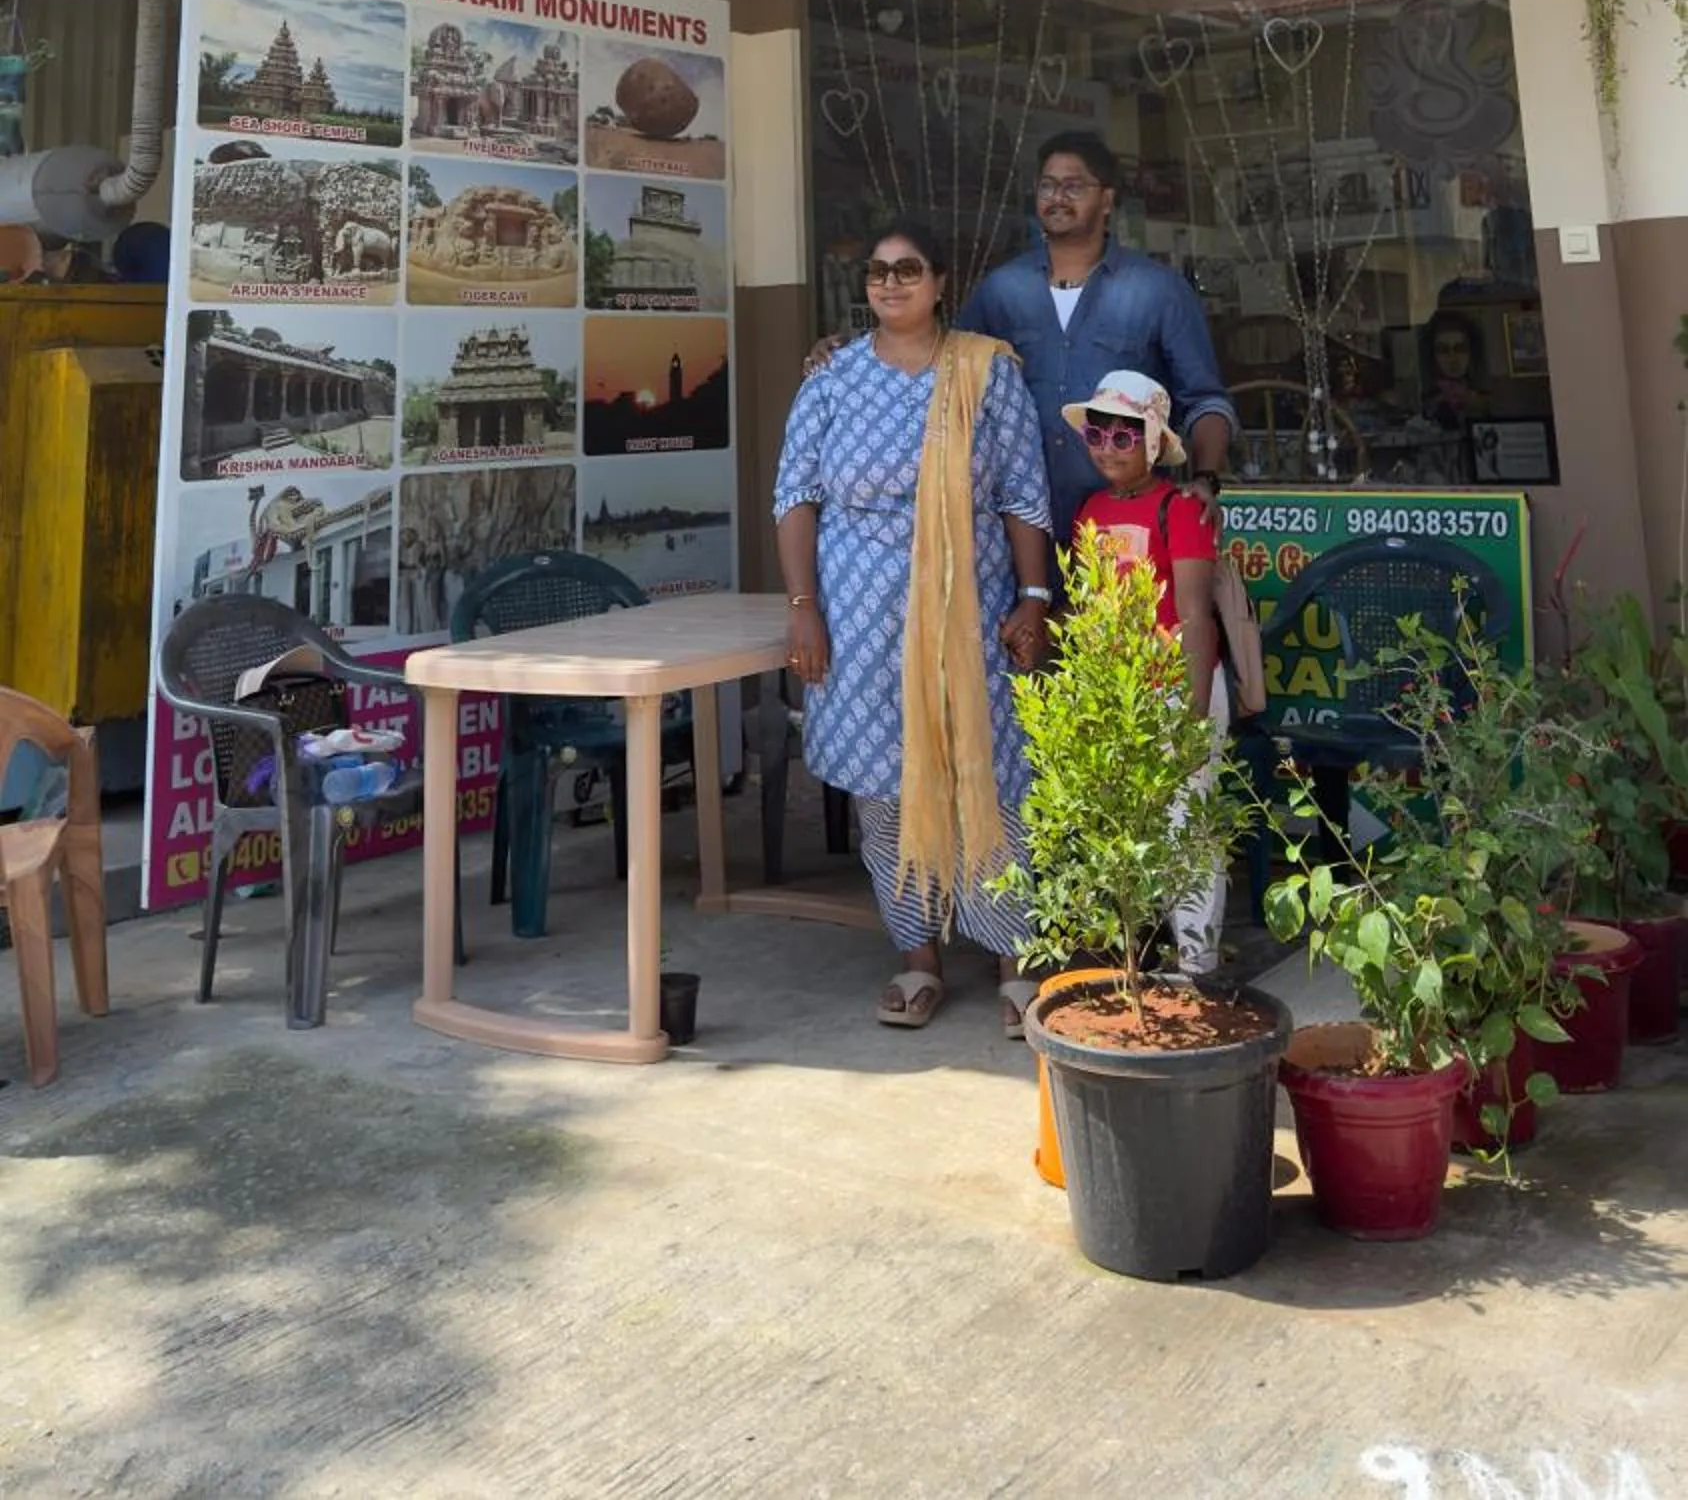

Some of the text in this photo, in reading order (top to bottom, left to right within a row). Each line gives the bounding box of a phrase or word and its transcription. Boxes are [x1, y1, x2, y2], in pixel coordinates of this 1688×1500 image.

[229, 115, 367, 141] SEA SHORE TEMPLE
[303, 285, 367, 298] PENANCE
[219, 455, 366, 474] KRISHNA MANDABAM
[1347, 511, 1507, 537] 9840383570
